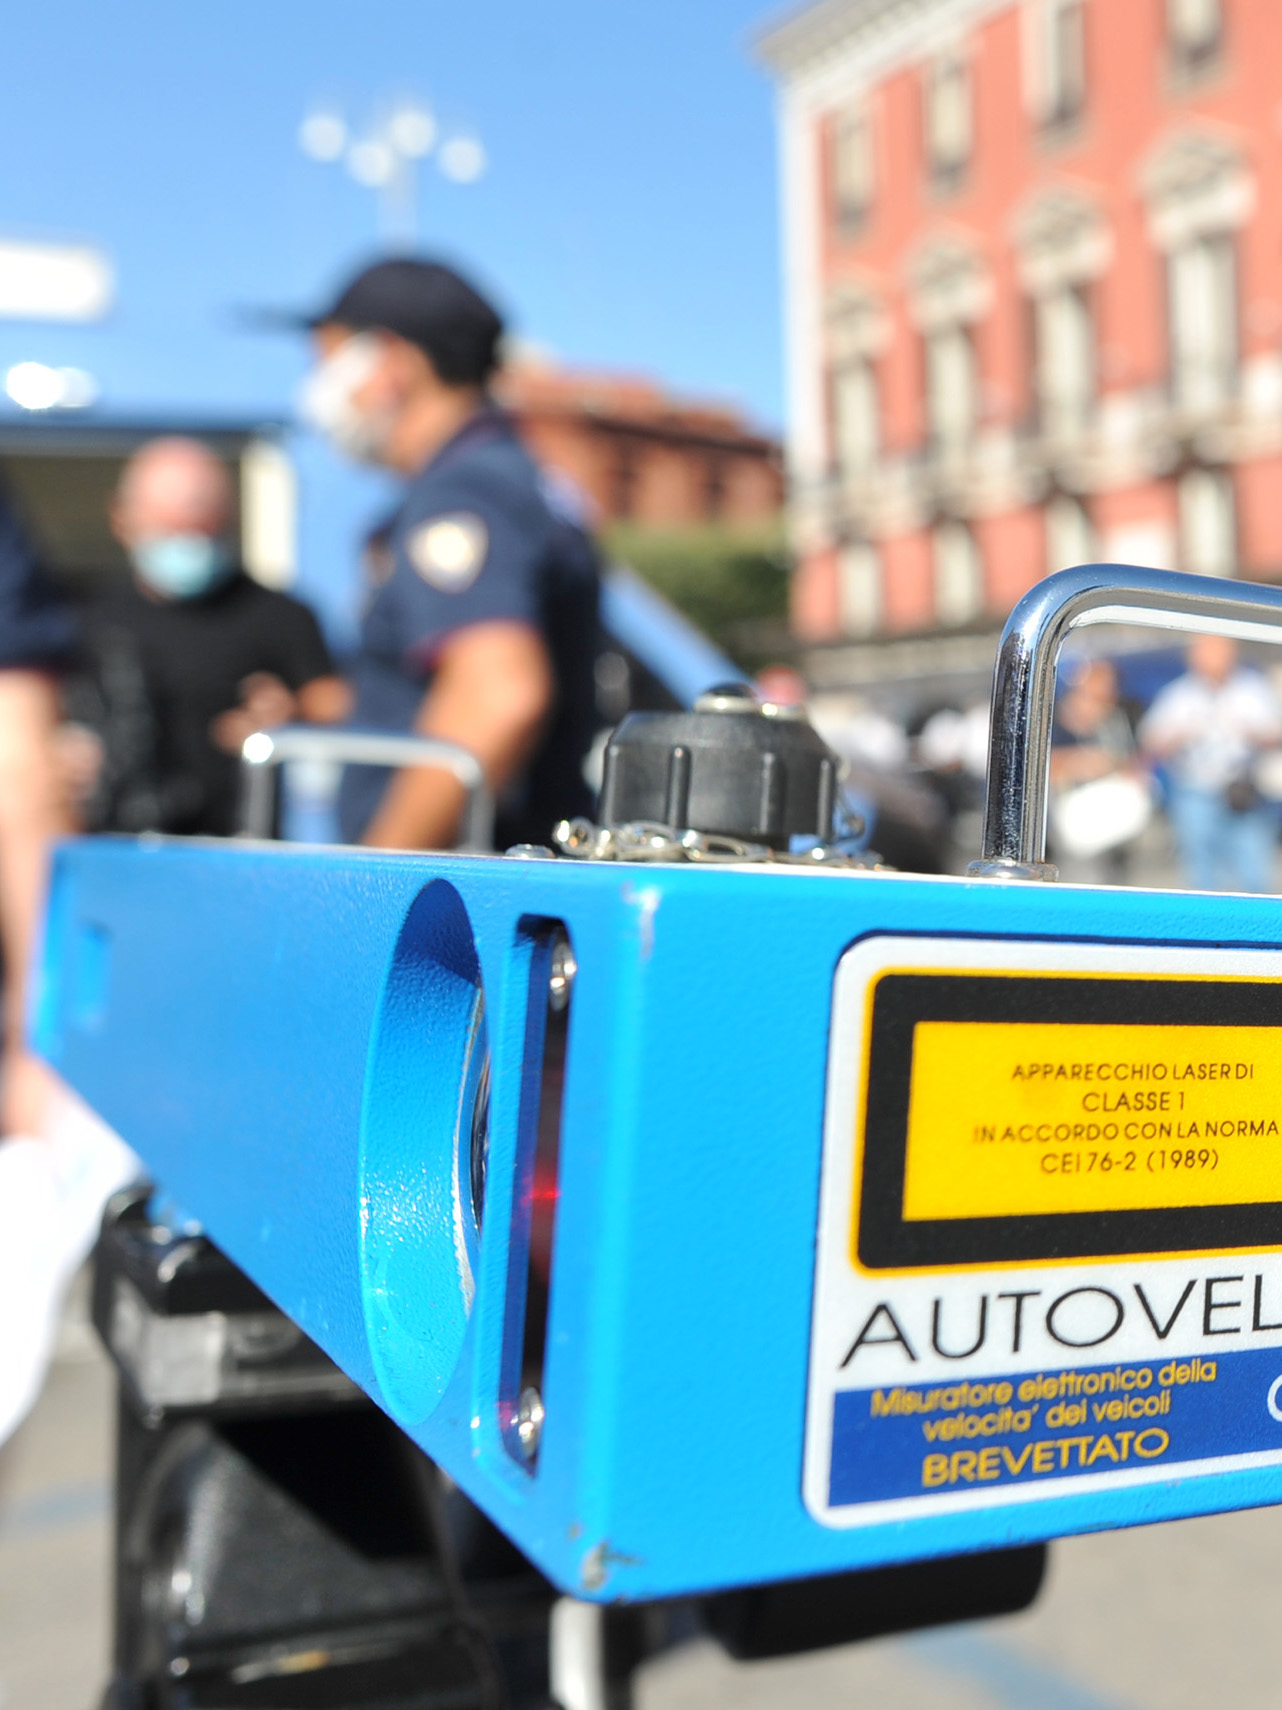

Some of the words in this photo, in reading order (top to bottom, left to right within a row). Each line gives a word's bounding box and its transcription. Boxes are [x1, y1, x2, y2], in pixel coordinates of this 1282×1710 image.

[1012, 1063, 1167, 1082] APPARECCHIO
[1173, 1063, 1230, 1080] LASER
[1236, 1062, 1254, 1080] DI
[1082, 1092, 1170, 1112] CLASSE
[1177, 1092, 1186, 1110] 1
[973, 1125, 996, 1144] IN
[1000, 1123, 1120, 1143] ACCORDO
[1124, 1122, 1172, 1139] CON
[1177, 1121, 1200, 1138] LA
[1205, 1119, 1279, 1137] NORMA
[1041, 1153, 1081, 1174] CEI
[1085, 1152, 1137, 1172] 76-2
[1147, 1149, 1219, 1172] (1989)
[870, 1381, 1013, 1417] Misuratore
[1017, 1365, 1153, 1401] elettronico
[1158, 1358, 1217, 1386] della
[1046, 1403, 1087, 1428] dei
[1093, 1389, 1170, 1422] veicoli
[922, 1427, 1169, 1488] BREVETTATO
